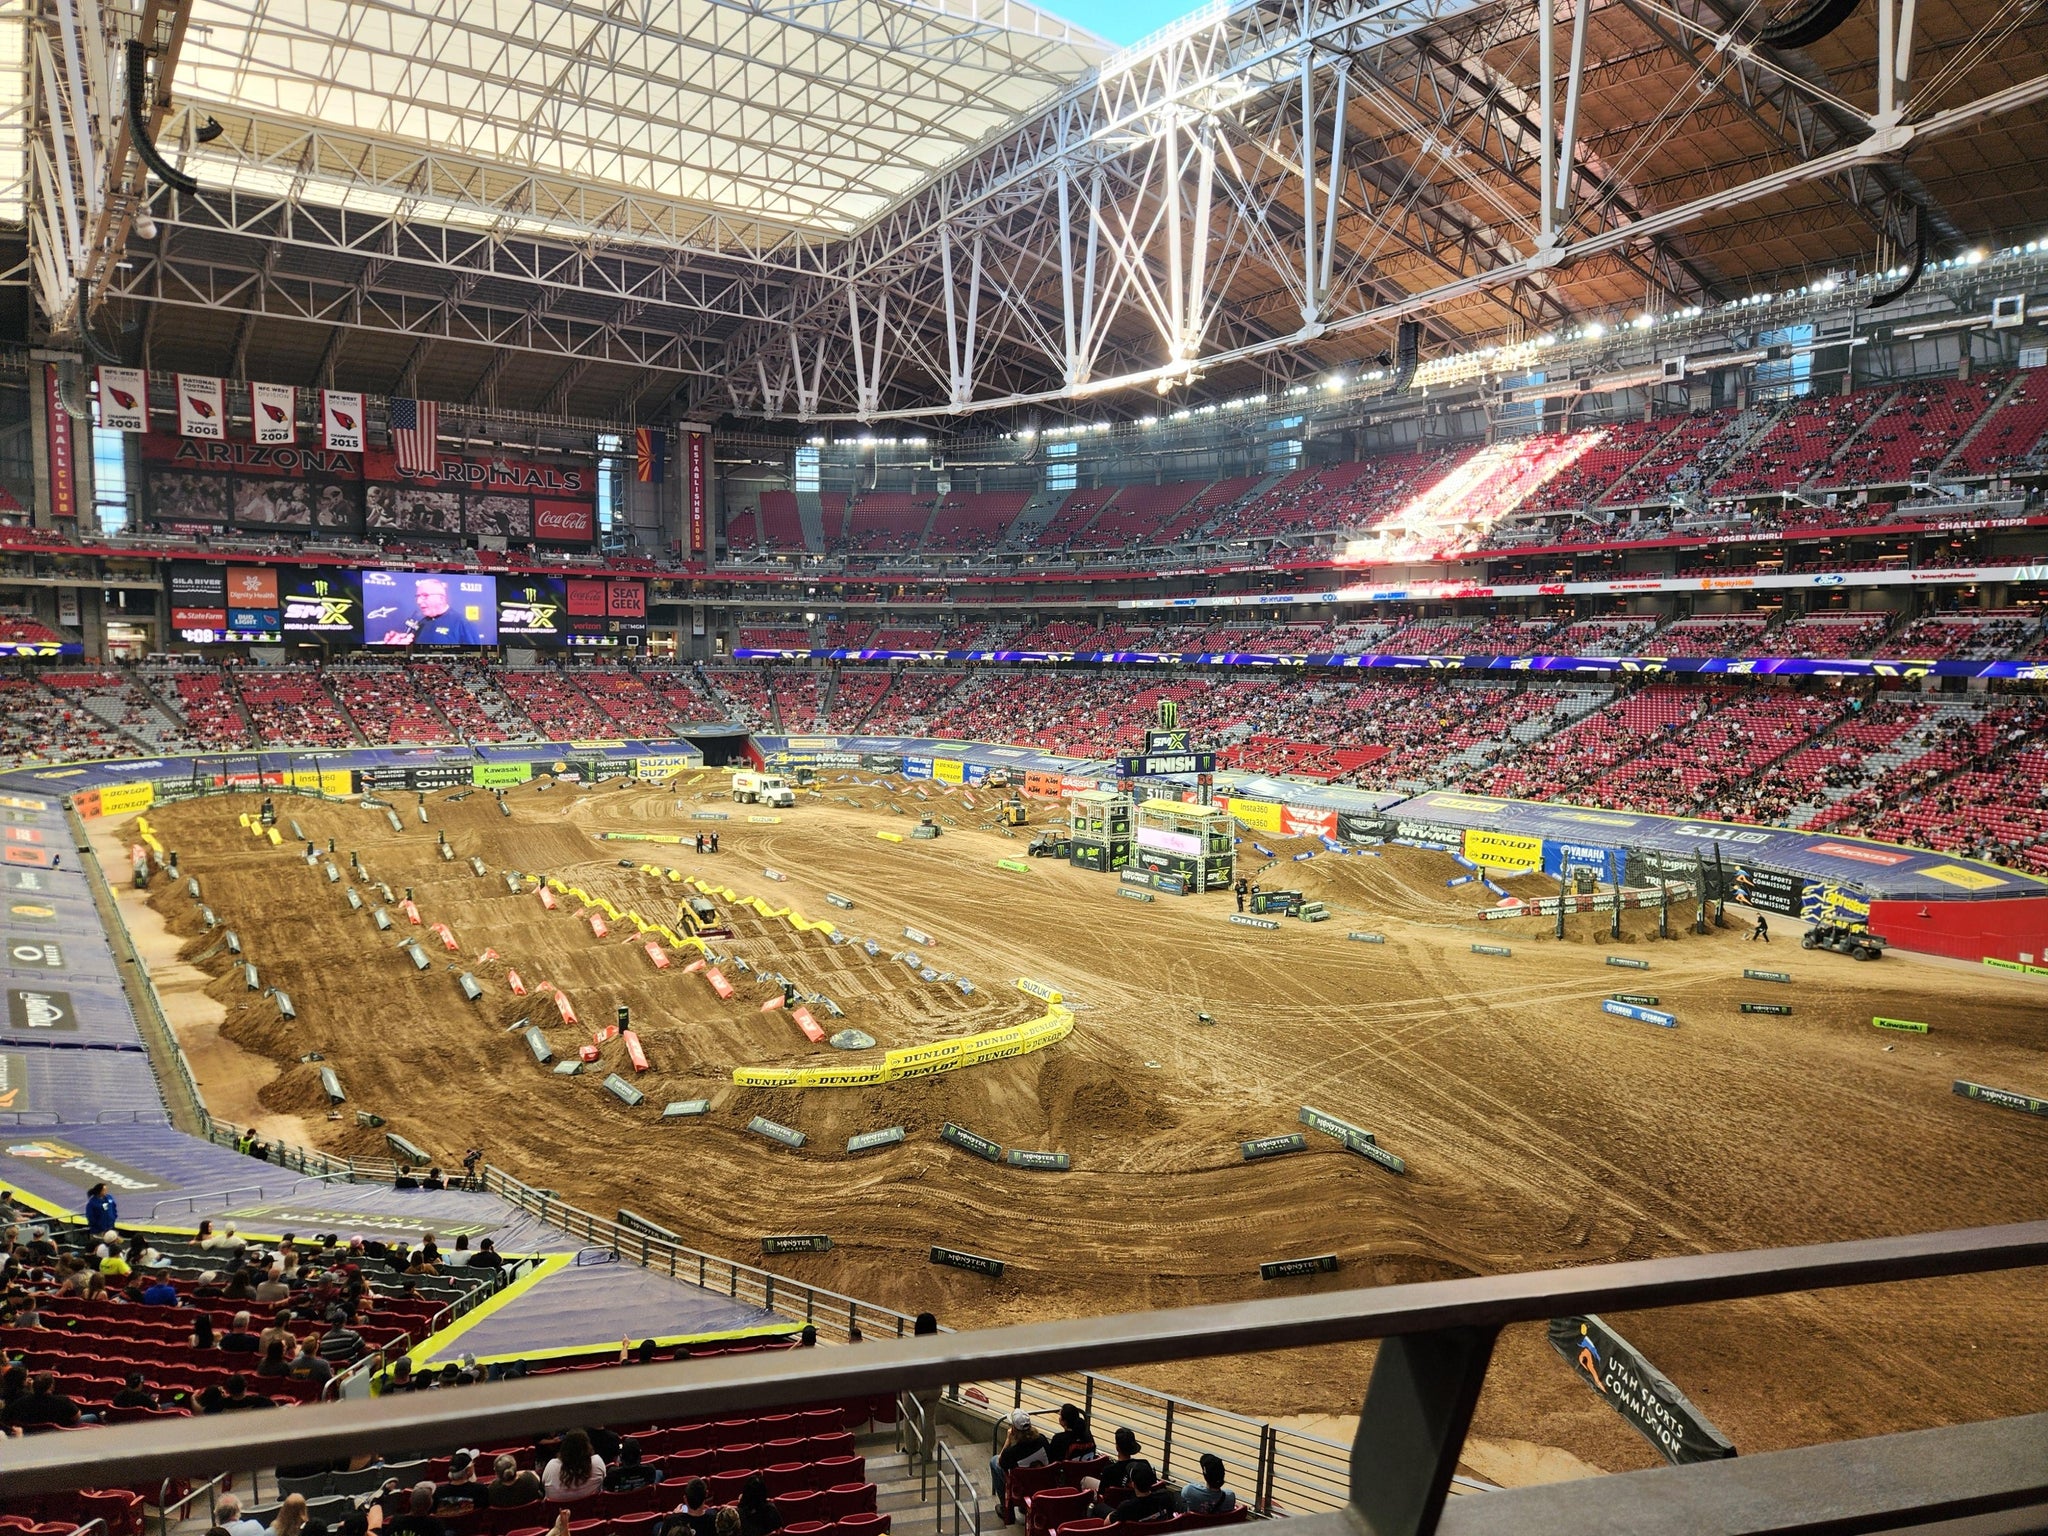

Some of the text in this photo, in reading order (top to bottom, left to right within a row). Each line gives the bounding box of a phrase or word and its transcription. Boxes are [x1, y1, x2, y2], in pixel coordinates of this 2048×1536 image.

[183, 377, 216, 386] NATIONAL
[183, 382, 216, 391] FOOTBALL
[258, 392, 290, 400] DIVISION
[108, 420, 141, 429] 2008
[187, 426, 218, 436] 2008
[260, 432, 289, 440] 2009
[330, 438, 358, 448] 2015
[175, 439, 355, 473] ARIZONA
[58, 469, 68, 513] CLUB
[538, 510, 587, 529] Coca-Cola
[1924, 518, 2028, 531] 62 CHARLEY TRIPPI
[1707, 532, 1783, 544] 22 ROGER WEHRLI
[1818, 576, 1843, 584] Ford
[230, 592, 252, 600] Dignity
[570, 590, 601, 601] Coca-Cola
[613, 588, 640, 598] SEAT
[612, 600, 640, 610] GEEK
[284, 602, 352, 624] SMX
[500, 607, 557, 628] SMX
[574, 622, 602, 630] verizon
[1152, 733, 1186, 750] SMX
[597, 760, 628, 768] MONSTER
[640, 758, 686, 766] SUZUKI
[1146, 756, 1196, 774] FINISH
[484, 766, 522, 774] Kawasaki
[300, 774, 336, 782] Insta360
[1046, 776, 1058, 785] KTM
[1061, 778, 1096, 788] GASGAS
[110, 786, 149, 797] DUNLOP
[1028, 786, 1040, 795] KTM
[1045, 788, 1058, 796] KTM
[111, 800, 149, 811] DUNLOP
[1240, 803, 1268, 814] Insta360
[1287, 807, 1331, 820] FLY
[1350, 818, 1378, 829] TRIUMPH
[1408, 822, 1461, 834] ROCKY MOUNTAIN
[1674, 825, 1738, 840] 5.11
[1481, 837, 1536, 850] DUNLOP
[1572, 846, 1605, 860] YAMAHA
[1480, 853, 1536, 866] DUNLOP
[1208, 868, 1230, 882] SMX
[1754, 872, 1792, 885] UTAH SPORTS
[1752, 878, 1792, 892] COMMISSION
[1752, 891, 1790, 905] UTAH SPORTS
[1750, 898, 1790, 912] COMMISSION
[1242, 918, 1274, 928] OAKLEY
[1988, 960, 2020, 970] Kawasaki
[1022, 980, 1050, 999] SUZUKI
[1030, 1019, 1059, 1036] DUNLOP
[1880, 1020, 1923, 1032] Kawasaki
[976, 1032, 1020, 1048] DUNLOP
[1032, 1032, 1062, 1048] DUNLOP
[904, 1046, 960, 1064] DUNLOP
[976, 1046, 1020, 1063] DUNLOP
[903, 1060, 958, 1078] DUNLOP
[746, 1078, 797, 1086] DUNLOP
[819, 1074, 880, 1084] DUNLOP
[614, 1080, 633, 1094] MONSTER
[1982, 1088, 2026, 1106] MONSTER
[764, 1122, 792, 1136] MONSTER
[1317, 1118, 1348, 1136] MONSTER
[860, 1131, 889, 1142] MONSTER
[958, 1130, 988, 1150] MONSTER
[1256, 1138, 1290, 1148] MONSTER
[1022, 1152, 1055, 1162] MONSTER
[1361, 1142, 1392, 1160] MONSTER
[630, 1220, 660, 1238] MONSTER
[776, 1240, 812, 1248] MONSTER
[948, 1253, 986, 1268] MONSTER
[1279, 1261, 1320, 1272] MONSTER
[1608, 1356, 1684, 1439] UTAH SPORTS
[1605, 1374, 1682, 1454] COMMISSION
